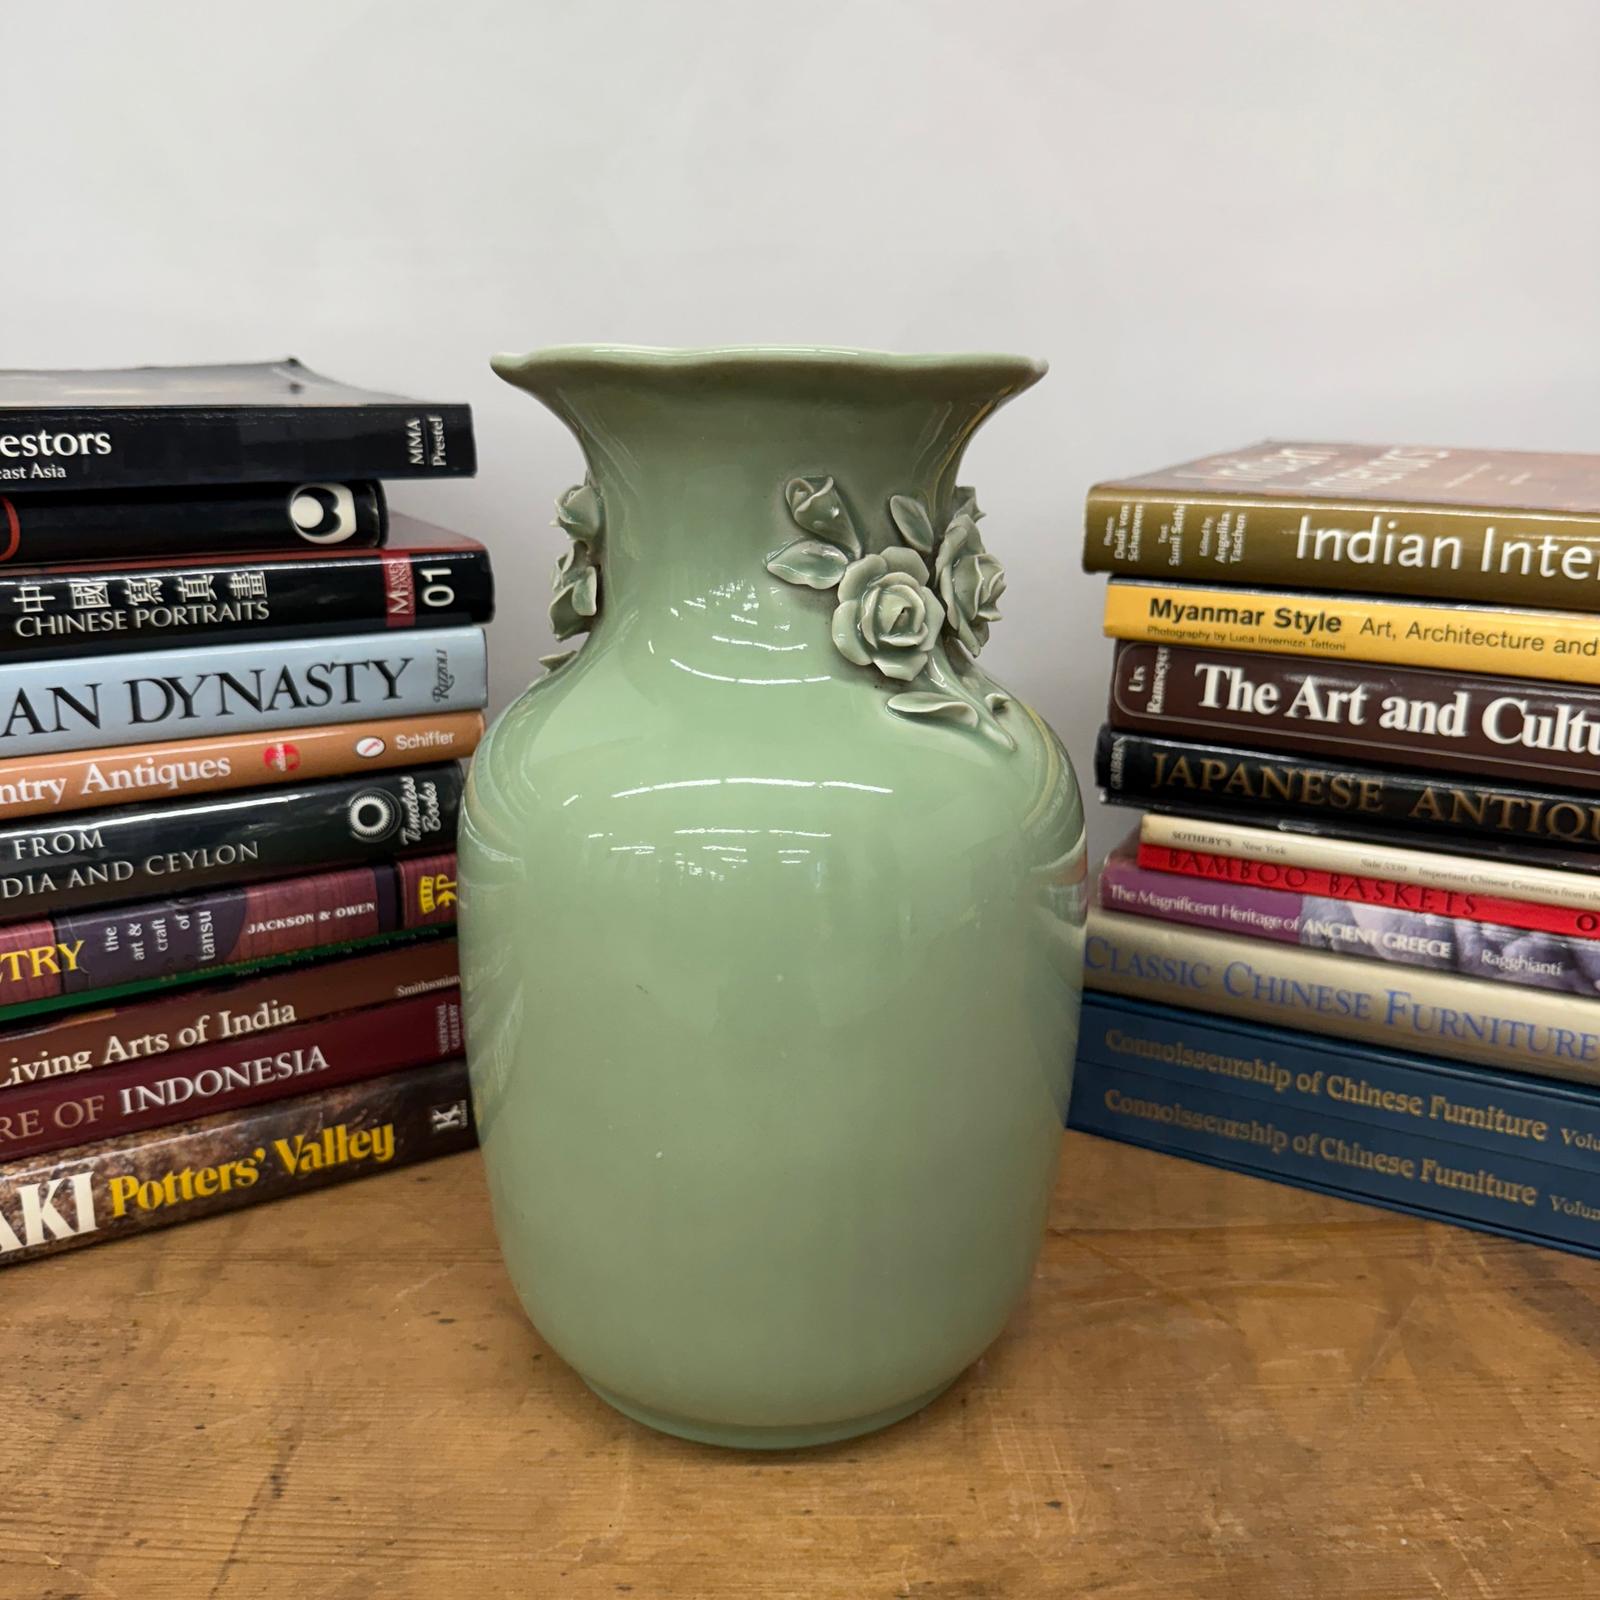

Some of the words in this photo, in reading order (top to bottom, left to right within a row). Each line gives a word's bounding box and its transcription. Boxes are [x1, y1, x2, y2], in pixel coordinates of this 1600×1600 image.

[0, 428, 112, 458] estors
[405, 418, 424, 465] MMA
[427, 415, 447, 467] Prestel
[0, 466, 27, 480] ast
[30, 462, 67, 479] Asia
[1119, 503, 1129, 527] von
[1171, 503, 1185, 534] Sethi
[1215, 511, 1231, 564] Angelika
[1230, 512, 1247, 564] Taschen
[1114, 529, 1126, 560] Deidi
[1169, 536, 1182, 567] Sunil
[1296, 515, 1461, 570] Indian
[420, 568, 455, 607] 01
[14, 610, 128, 637] CHINESE
[135, 600, 270, 628] PORTRAITS
[1147, 624, 1211, 641] Photography
[1214, 631, 1226, 643] by
[1229, 632, 1254, 644] Luca
[1149, 598, 1265, 626] Myanmar
[1273, 607, 1342, 635] Style
[1360, 617, 1397, 640] Art,
[1405, 621, 1545, 651] Architecture
[1553, 638, 1598, 656] and
[0, 682, 102, 738] AN
[123, 657, 414, 725] DYNASTY
[1128, 665, 1146, 692] Urs
[1147, 645, 1170, 713] Ramseyer
[1195, 663, 1280, 715] The
[1284, 675, 1368, 725] Art
[1379, 690, 1470, 737] and
[395, 731, 456, 750] Schiffer
[0, 776, 68, 805] ntry
[80, 757, 232, 796] Antiques
[1151, 752, 1383, 813] JAPANESE
[1408, 786, 1600, 843] ANTIQ
[400, 776, 421, 846] Timeless
[418, 781, 441, 832] Books
[1, 873, 59, 899] DIA
[68, 861, 134, 888] AND
[145, 840, 259, 876] CEYLON
[13, 830, 105, 861] FROM
[1171, 831, 1232, 847] SOTHEBY'S
[1242, 840, 1261, 851] New
[1263, 842, 1287, 855] York
[1418, 867, 1468, 882] Important
[1470, 873, 1512, 888] Chinese
[1512, 880, 1560, 895] Ceramics
[1561, 888, 1587, 900] from
[1168, 850, 1308, 888] BAMBOO
[1329, 872, 1478, 916] BASKETS
[1576, 913, 1598, 932] O
[105, 925, 119, 952] the
[128, 923, 142, 937] &
[152, 917, 168, 952] craft
[175, 914, 190, 930] of
[199, 910, 215, 962] tansu
[247, 912, 315, 935] JACKSON
[319, 909, 331, 921] &
[336, 902, 376, 916] OWEN
[1109, 884, 1136, 901] The
[1137, 890, 1218, 917] Magnificent
[1222, 904, 1282, 930] Heritage
[1283, 916, 1301, 931] of
[1302, 918, 1378, 945] ANCIENT
[1382, 931, 1453, 960] GREECE
[1481, 949, 1563, 976] Ragghianti
[0, 940, 85, 984] TRY
[130, 941, 145, 961] art
[397, 974, 460, 997] Smithsonian
[1085, 936, 1211, 990] CLASSIC
[1223, 960, 1372, 1019] CHINESE
[1384, 988, 1600, 1062] FURNITURE
[103, 1035, 169, 1064] Arts
[178, 1015, 210, 1047] of
[219, 1000, 297, 1039] India
[54, 1095, 105, 1129] OF
[120, 1045, 330, 1117] INDONESIA
[1104, 1028, 1291, 1094] Connoisseurship
[1296, 1071, 1323, 1095] of
[1326, 1074, 1423, 1117] Chinese
[1429, 1094, 1549, 1141] Furniture
[109, 1147, 266, 1219] Potters'
[274, 1123, 396, 1177] Valley
[1104, 1088, 1288, 1155] Connoisseurship
[1292, 1133, 1320, 1157] of
[1320, 1137, 1414, 1179] Chinese
[1420, 1158, 1538, 1207] Furniture
